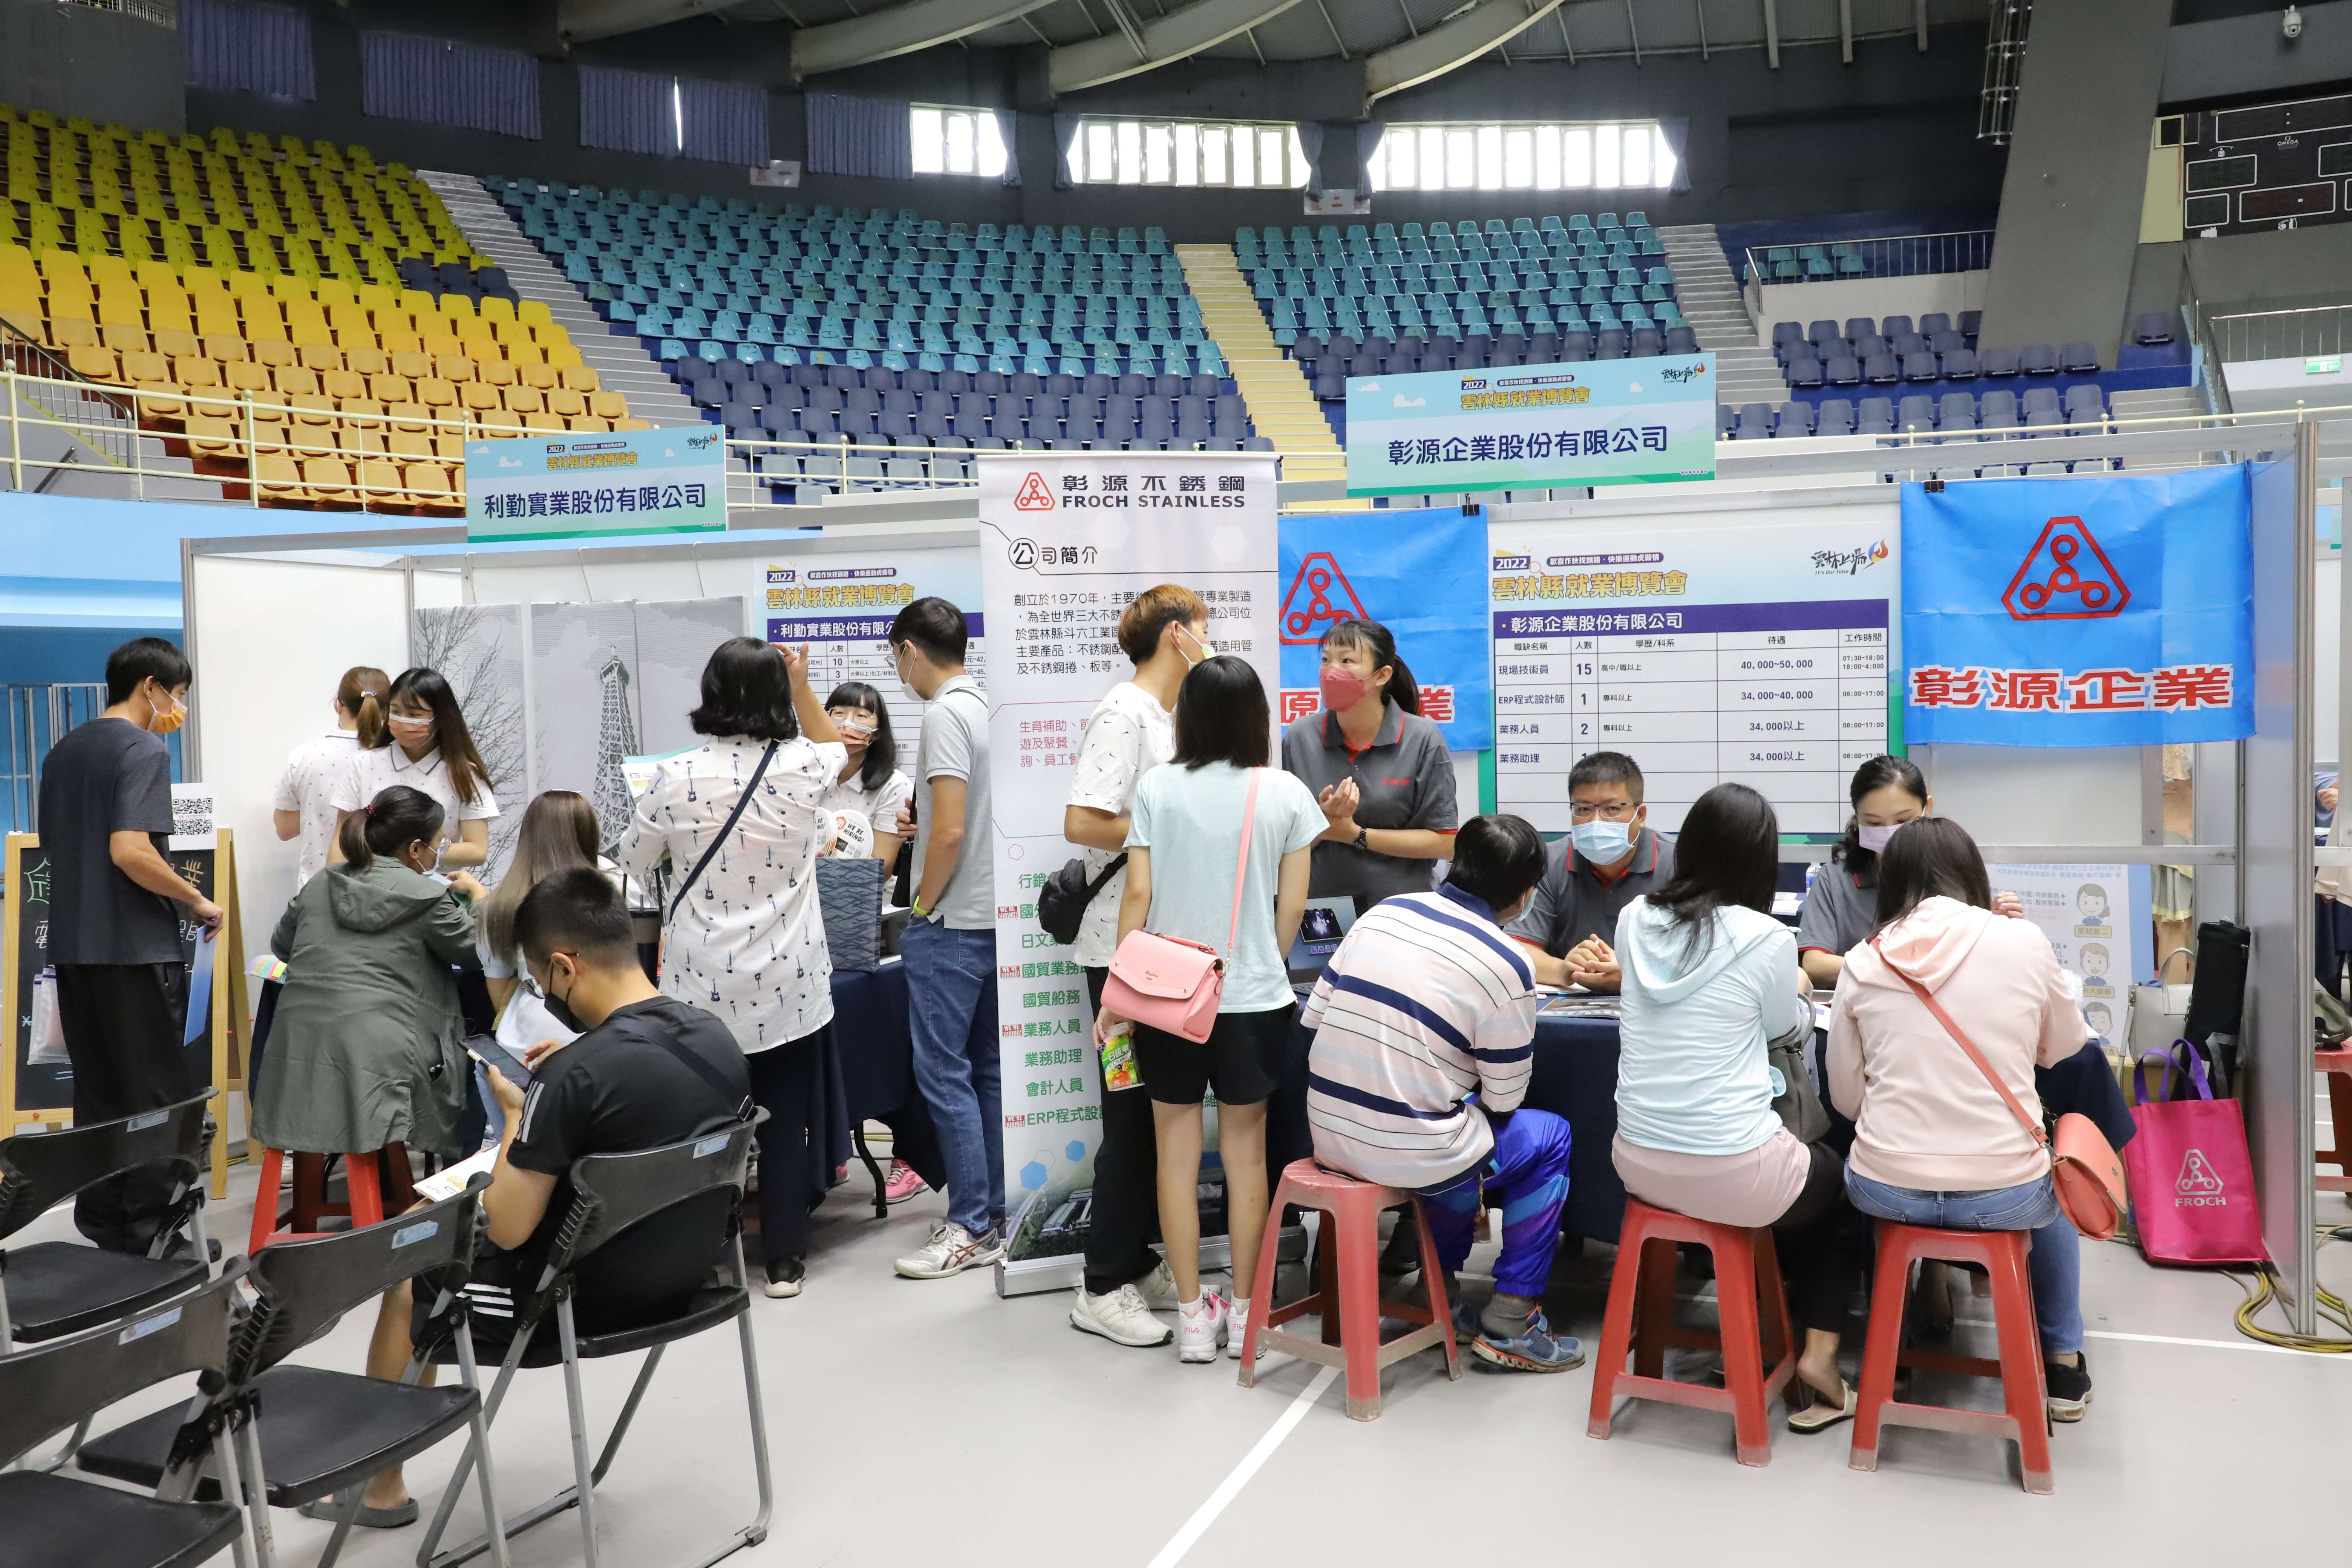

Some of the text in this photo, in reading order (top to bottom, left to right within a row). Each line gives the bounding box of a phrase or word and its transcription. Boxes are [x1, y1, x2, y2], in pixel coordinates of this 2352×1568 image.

[1463, 381, 1484, 389] 2022
[1461, 386, 1590, 410] 雲林縣就業博覽會
[1389, 426, 1667, 466] 彰源企業股份有限公司
[547, 451, 638, 470] 雲林縣就業博覽會
[1062, 475, 1245, 492] 彰源不銹鋼
[484, 483, 706, 519] 利勤實業股份有限公司
[1063, 495, 1245, 508] FROCH STAINLESS
[1012, 542, 1098, 565] 公司簡介
[1496, 558, 1527, 570] 2022
[769, 572, 793, 582] 2022
[1493, 570, 1687, 600] 雲林縣就業博覽會
[766, 583, 914, 609] 雲林縣就業博覽會
[1511, 612, 1683, 634] 彰源企業股份有限公司
[1015, 626, 1120, 640] 於雲林縣斗六工業區
[1845, 633, 1882, 642] 工作時間
[1514, 641, 1548, 651] 職缺名稱
[1575, 640, 1593, 650] 人數
[1767, 635, 1786, 645] 待遇
[1498, 664, 1549, 676] 現場技術員
[1577, 663, 1592, 676] 15
[1601, 663, 1642, 672] 高中/職以上
[1913, 665, 2231, 711] 彰源企業
[1498, 694, 1565, 705] ERP程式設計師
[1580, 693, 1586, 705] 1
[1603, 694, 1632, 702] 專科以上
[1499, 724, 1539, 735] 業務人員
[1580, 723, 1588, 735] 2
[1603, 724, 1632, 732] 專科以上
[1499, 752, 1540, 764] 業務助理
[843, 828, 865, 843] HIRING!
[1018, 873, 1049, 889] 行銷
[1023, 989, 1080, 1008] 國貿船務
[1024, 1018, 1081, 1038] 業務人員
[1024, 1048, 1082, 1067] 業務助理
[1102, 1044, 1130, 1062] 一日蔬果
[1026, 1078, 1083, 1097] 會計人員
[2174, 1196, 2226, 1207] FROCH
